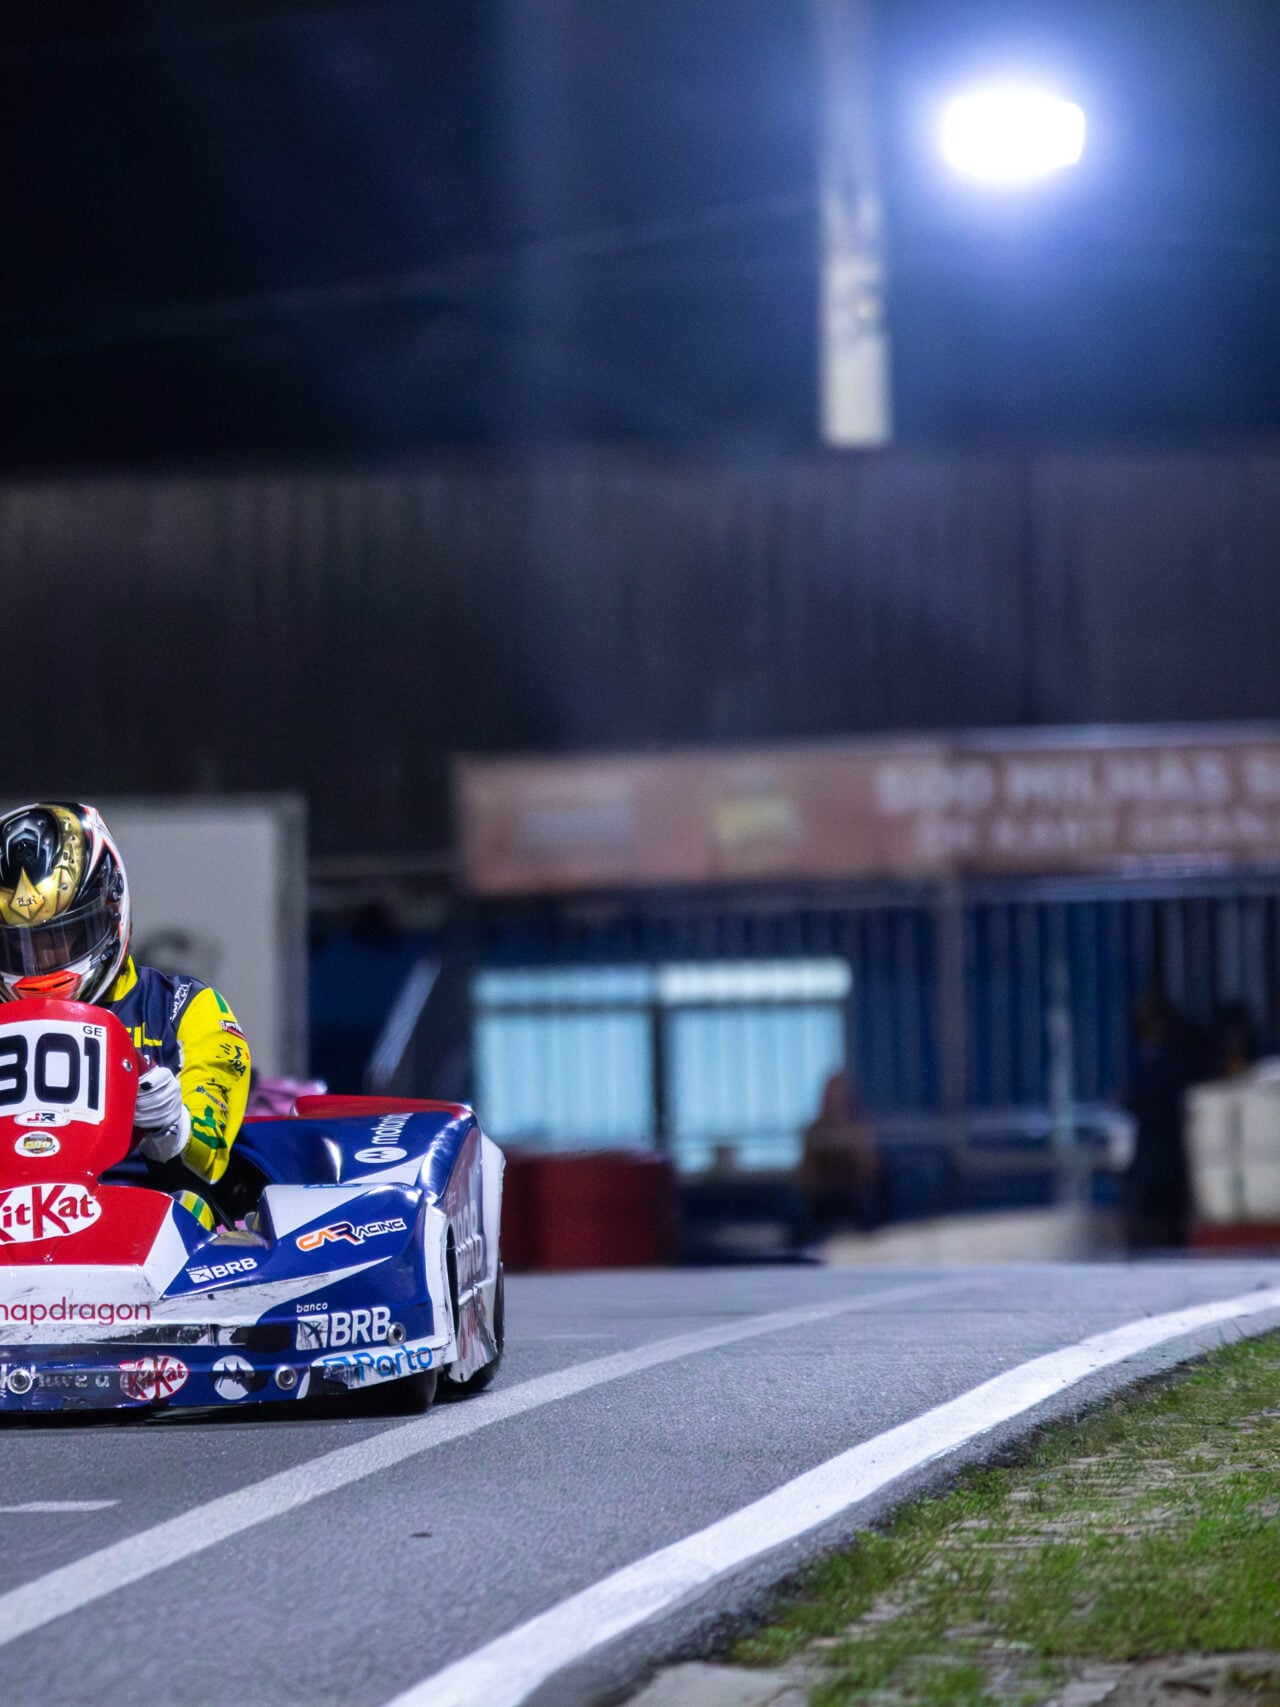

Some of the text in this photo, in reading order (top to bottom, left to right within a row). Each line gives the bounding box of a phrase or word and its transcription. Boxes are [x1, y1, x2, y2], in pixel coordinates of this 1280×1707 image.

[82, 1025, 103, 1037] GE
[26, 1112, 56, 1122] JR
[210, 1257, 258, 1279] BRB
[296, 1302, 329, 1313] banco
[329, 1306, 392, 1348] BRB
[353, 1345, 433, 1381] Porto
